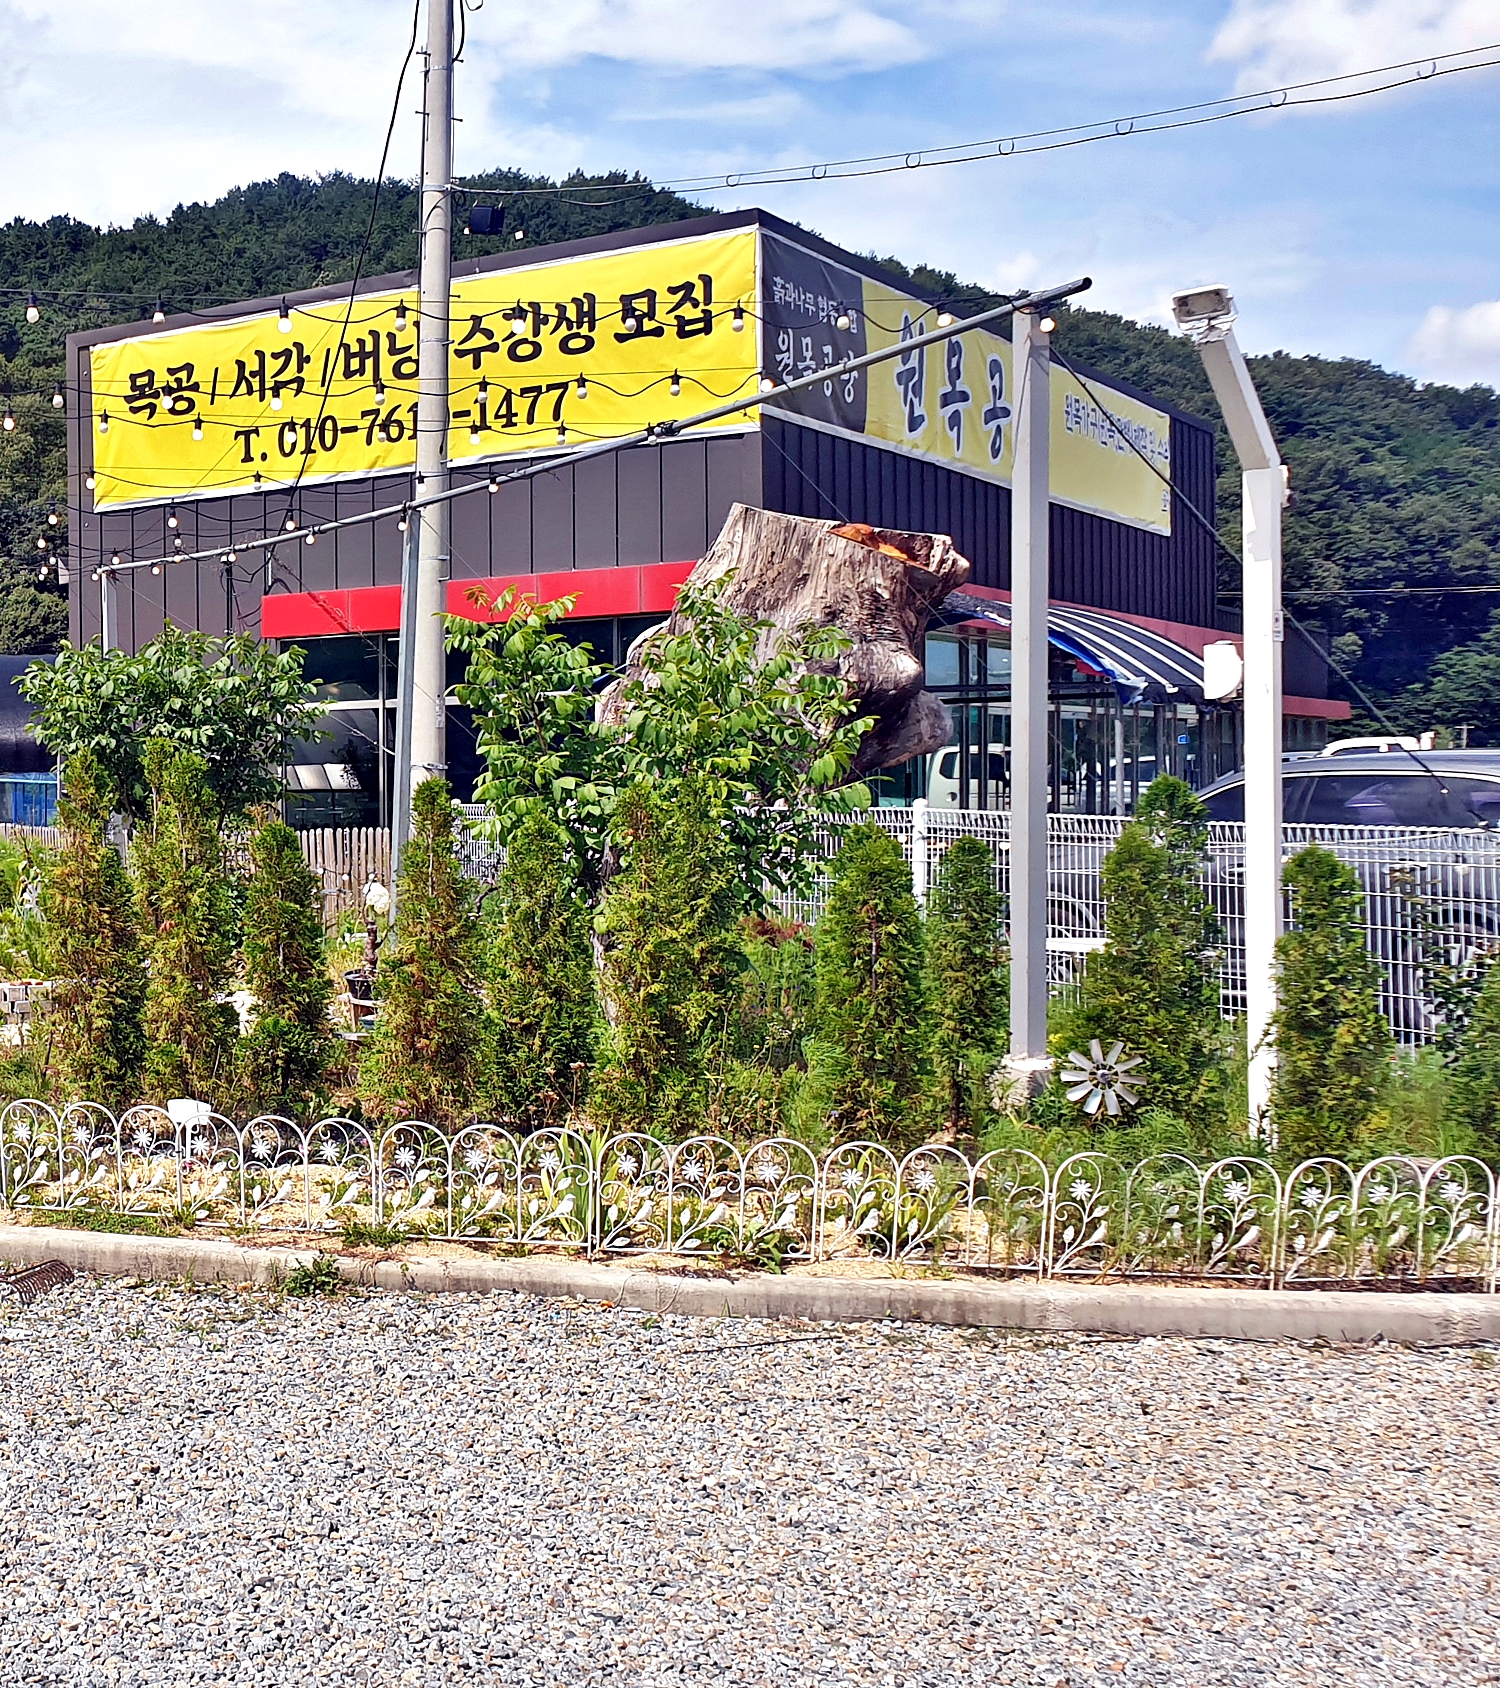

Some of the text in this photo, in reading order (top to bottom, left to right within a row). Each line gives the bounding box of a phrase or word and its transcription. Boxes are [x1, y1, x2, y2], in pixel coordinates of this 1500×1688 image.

[123, 361, 200, 420] 목공
[229, 341, 311, 403] 서각
[453, 292, 597, 371] 수강생
[612, 273, 714, 344] 모집
[817, 294, 859, 334] 협동합
